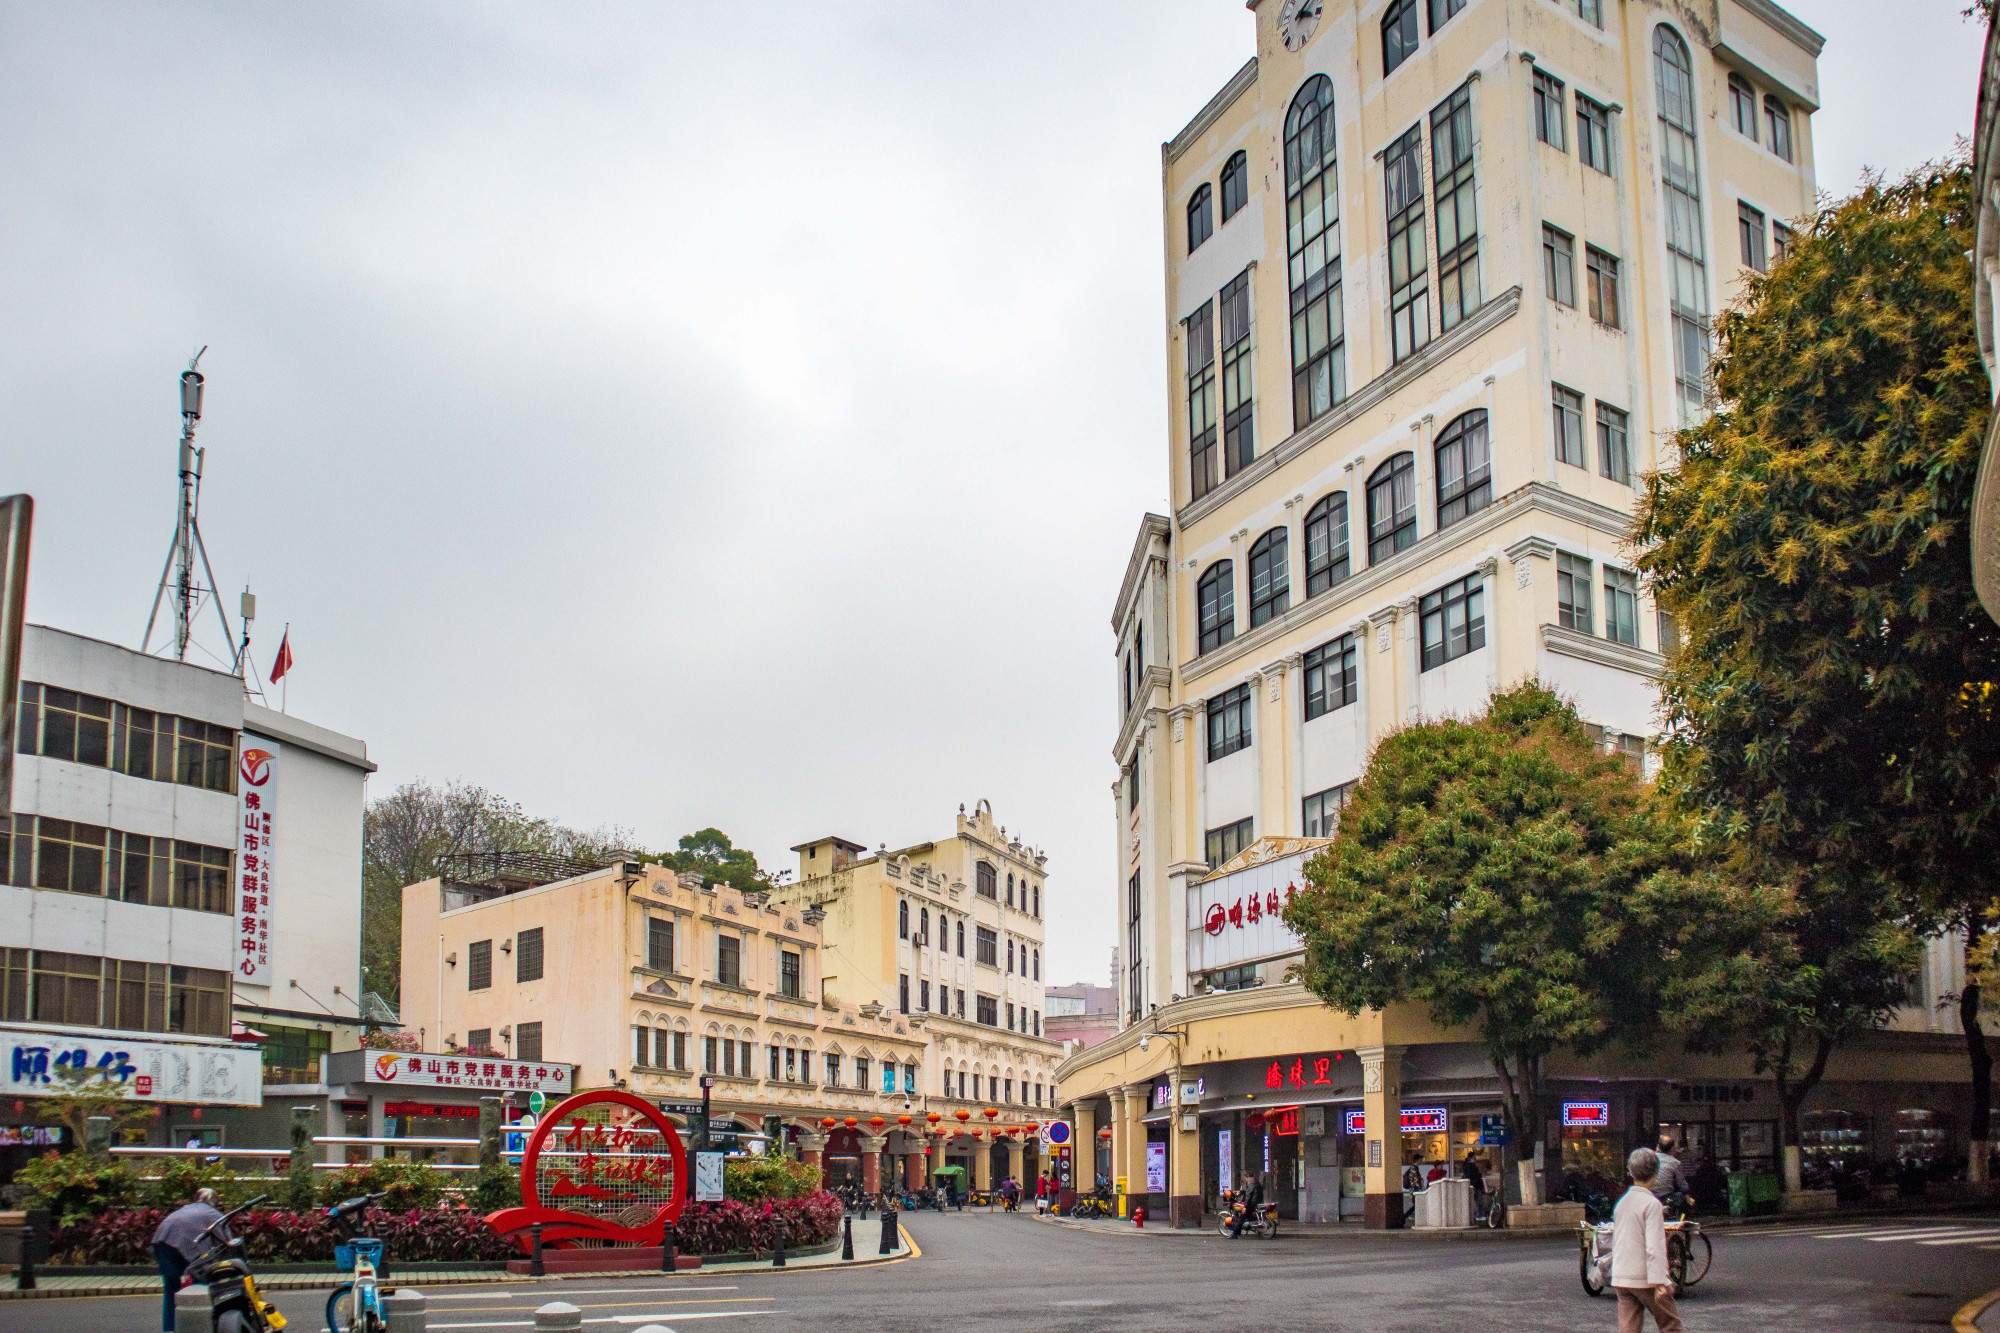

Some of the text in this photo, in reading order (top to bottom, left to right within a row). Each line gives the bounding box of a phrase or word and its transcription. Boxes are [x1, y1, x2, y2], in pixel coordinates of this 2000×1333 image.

[240, 791, 261, 977] 佛山市党群服务中心
[408, 1057, 565, 1082] 佛山市党群服务中心
[578, 1150, 673, 1188] 牢记使命
